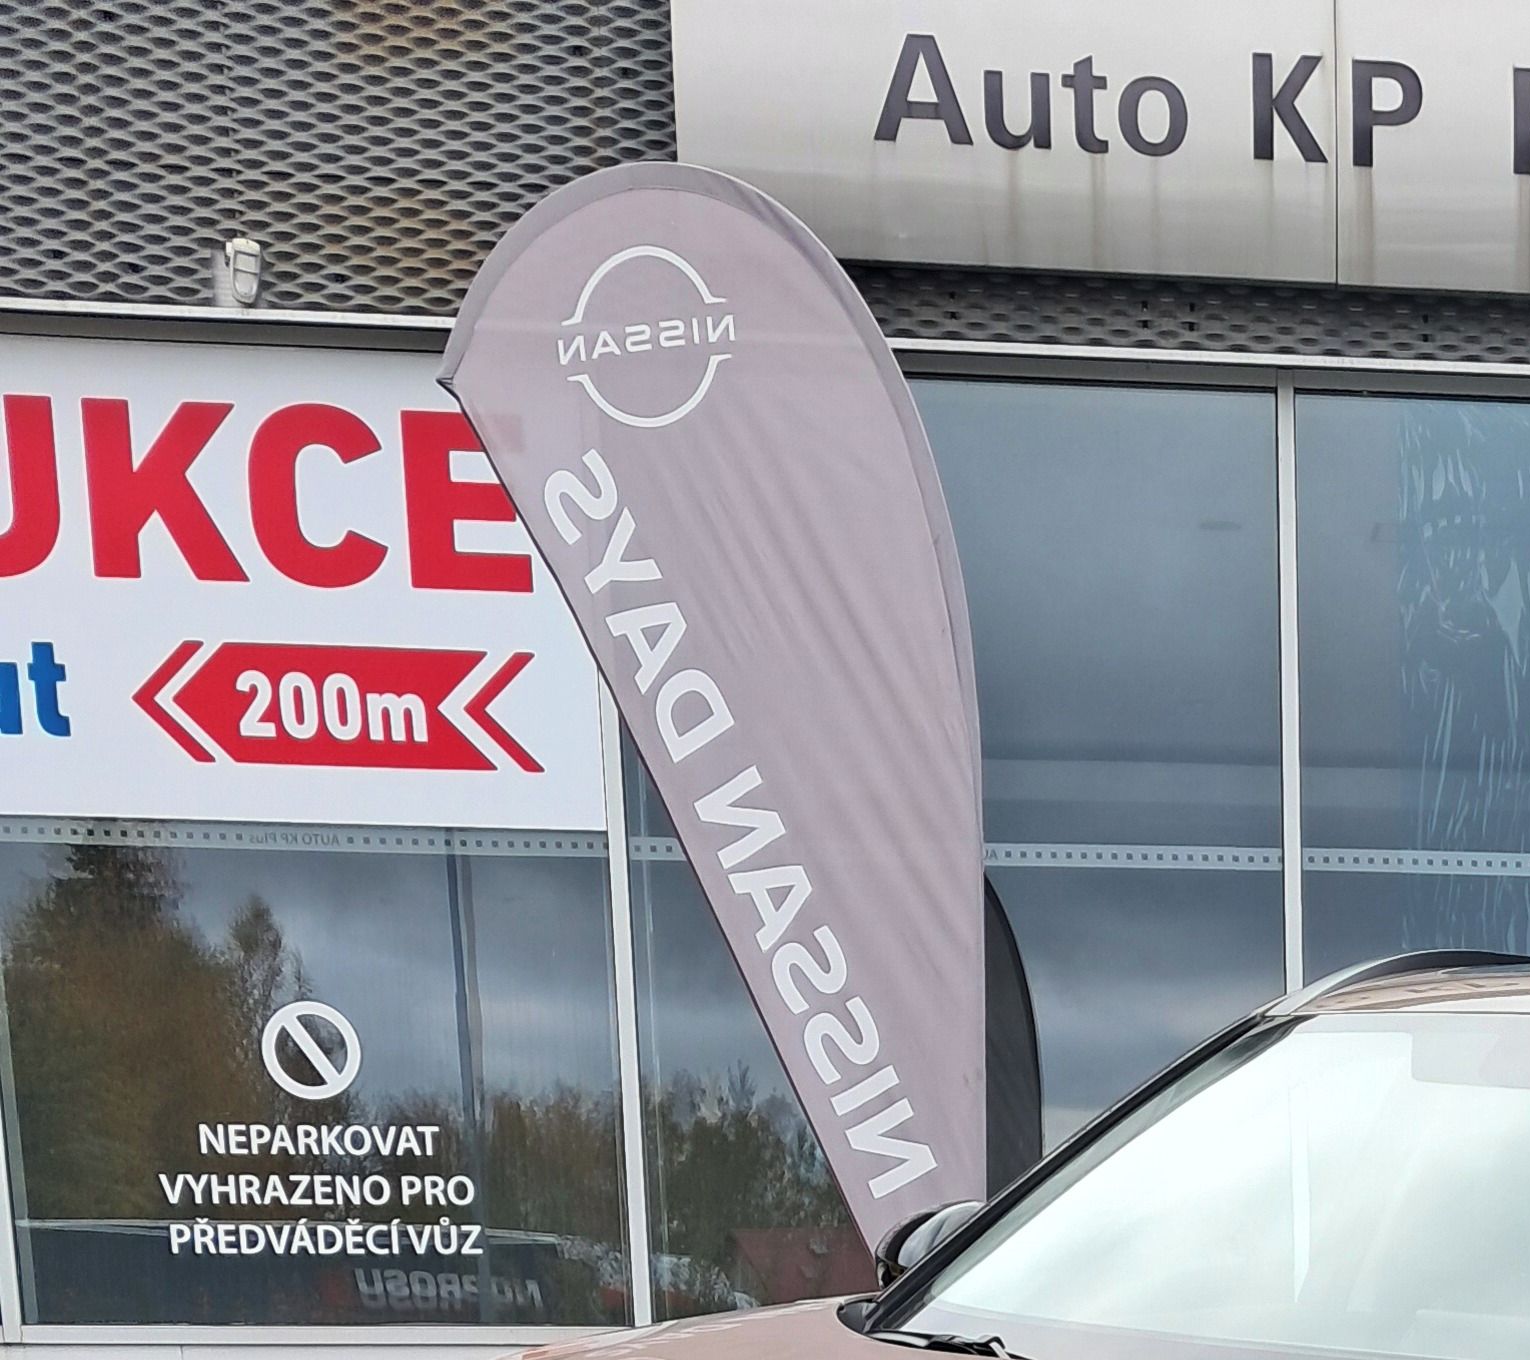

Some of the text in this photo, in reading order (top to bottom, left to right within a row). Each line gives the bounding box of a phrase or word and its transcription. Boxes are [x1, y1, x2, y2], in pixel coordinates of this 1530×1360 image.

[872, 32, 1190, 158] Auto
[1249, 51, 1424, 169] KP
[234, 669, 429, 744] 200m
[198, 1122, 440, 1157] NEPARKOVAT
[158, 1173, 475, 1206] VYHRAZENO PRO
[169, 1216, 484, 1255] PŘEDVÁDĚCÍ VŮZ
